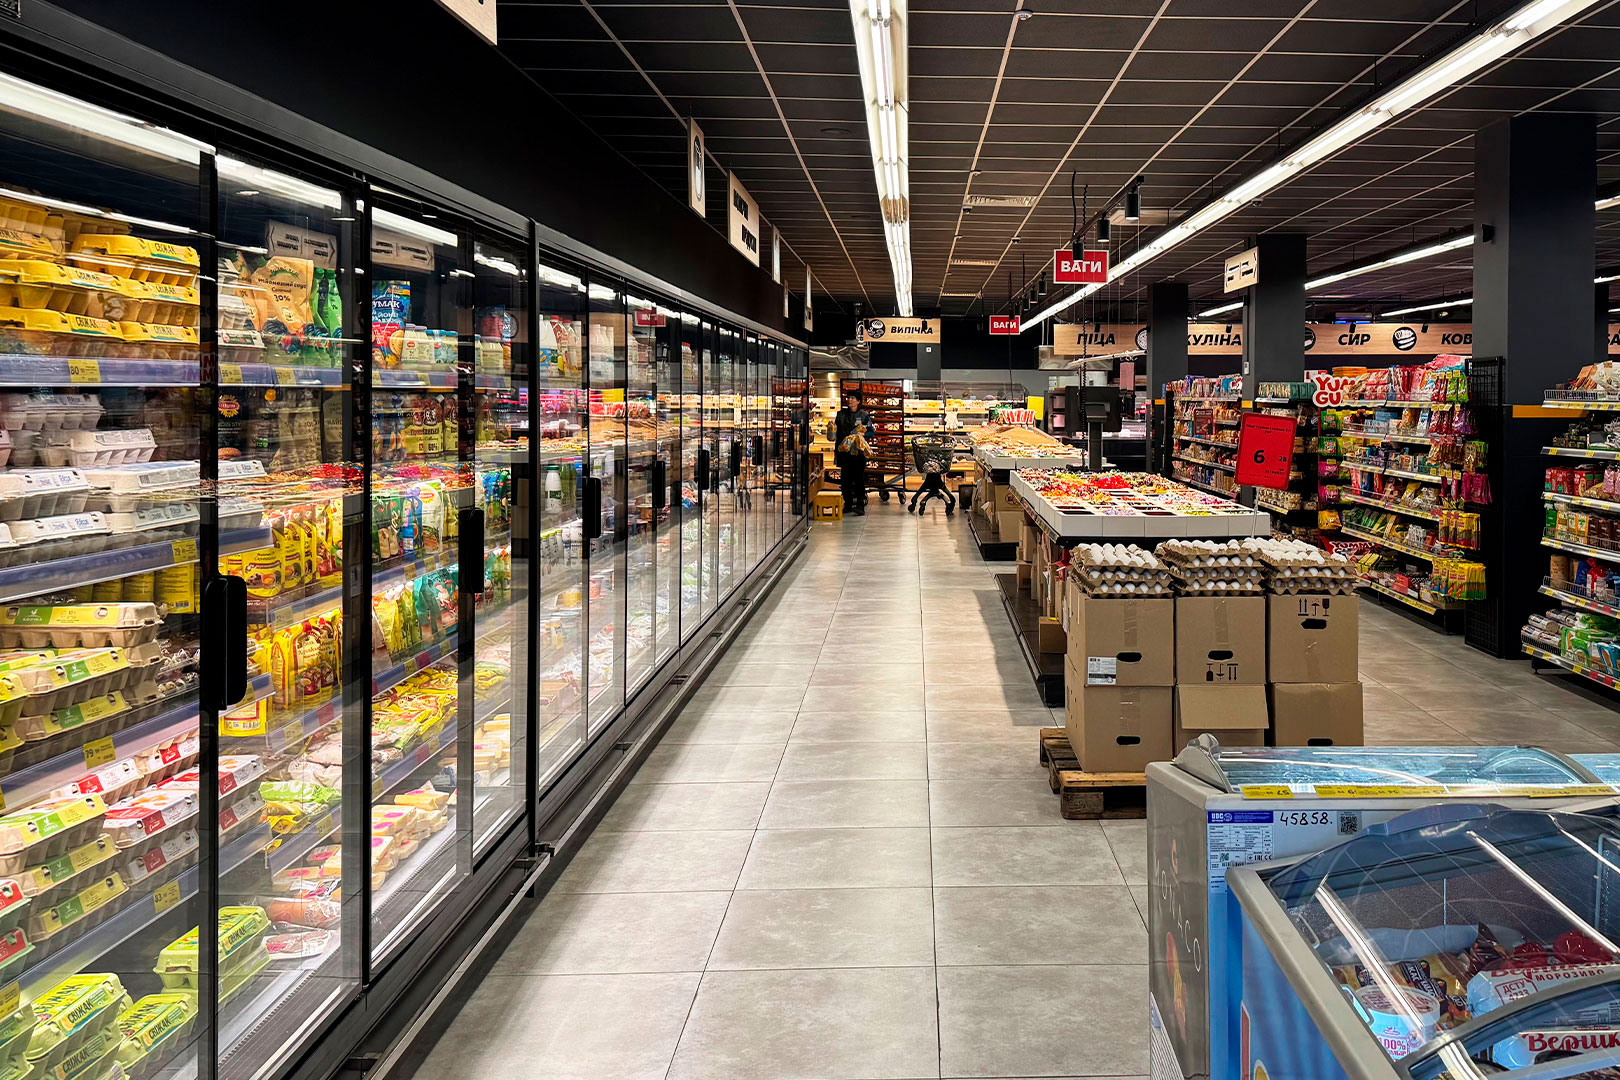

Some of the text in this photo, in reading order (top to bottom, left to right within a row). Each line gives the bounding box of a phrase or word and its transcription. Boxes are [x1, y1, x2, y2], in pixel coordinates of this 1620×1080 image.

[1060, 261, 1102, 273] ВАГИ
[890, 326, 934, 335] ВИПІЧКА
[993, 321, 1017, 329] ВАГИ
[1076, 334, 1116, 346] ПІЦА
[1338, 333, 1371, 346] СИР
[1441, 333, 1473, 345] КОВ
[1253, 449, 1265, 464] 6
[228, 925, 246, 946] СВІЖАК
[1535, 969, 1605, 982] МОРОЗИВО
[1502, 980, 1526, 995] ДСТУ
[67, 999, 94, 1024] СВІЖАК
[148, 1017, 171, 1040] СВІЖАК
[62, 1048, 90, 1074] СВІЖАК
